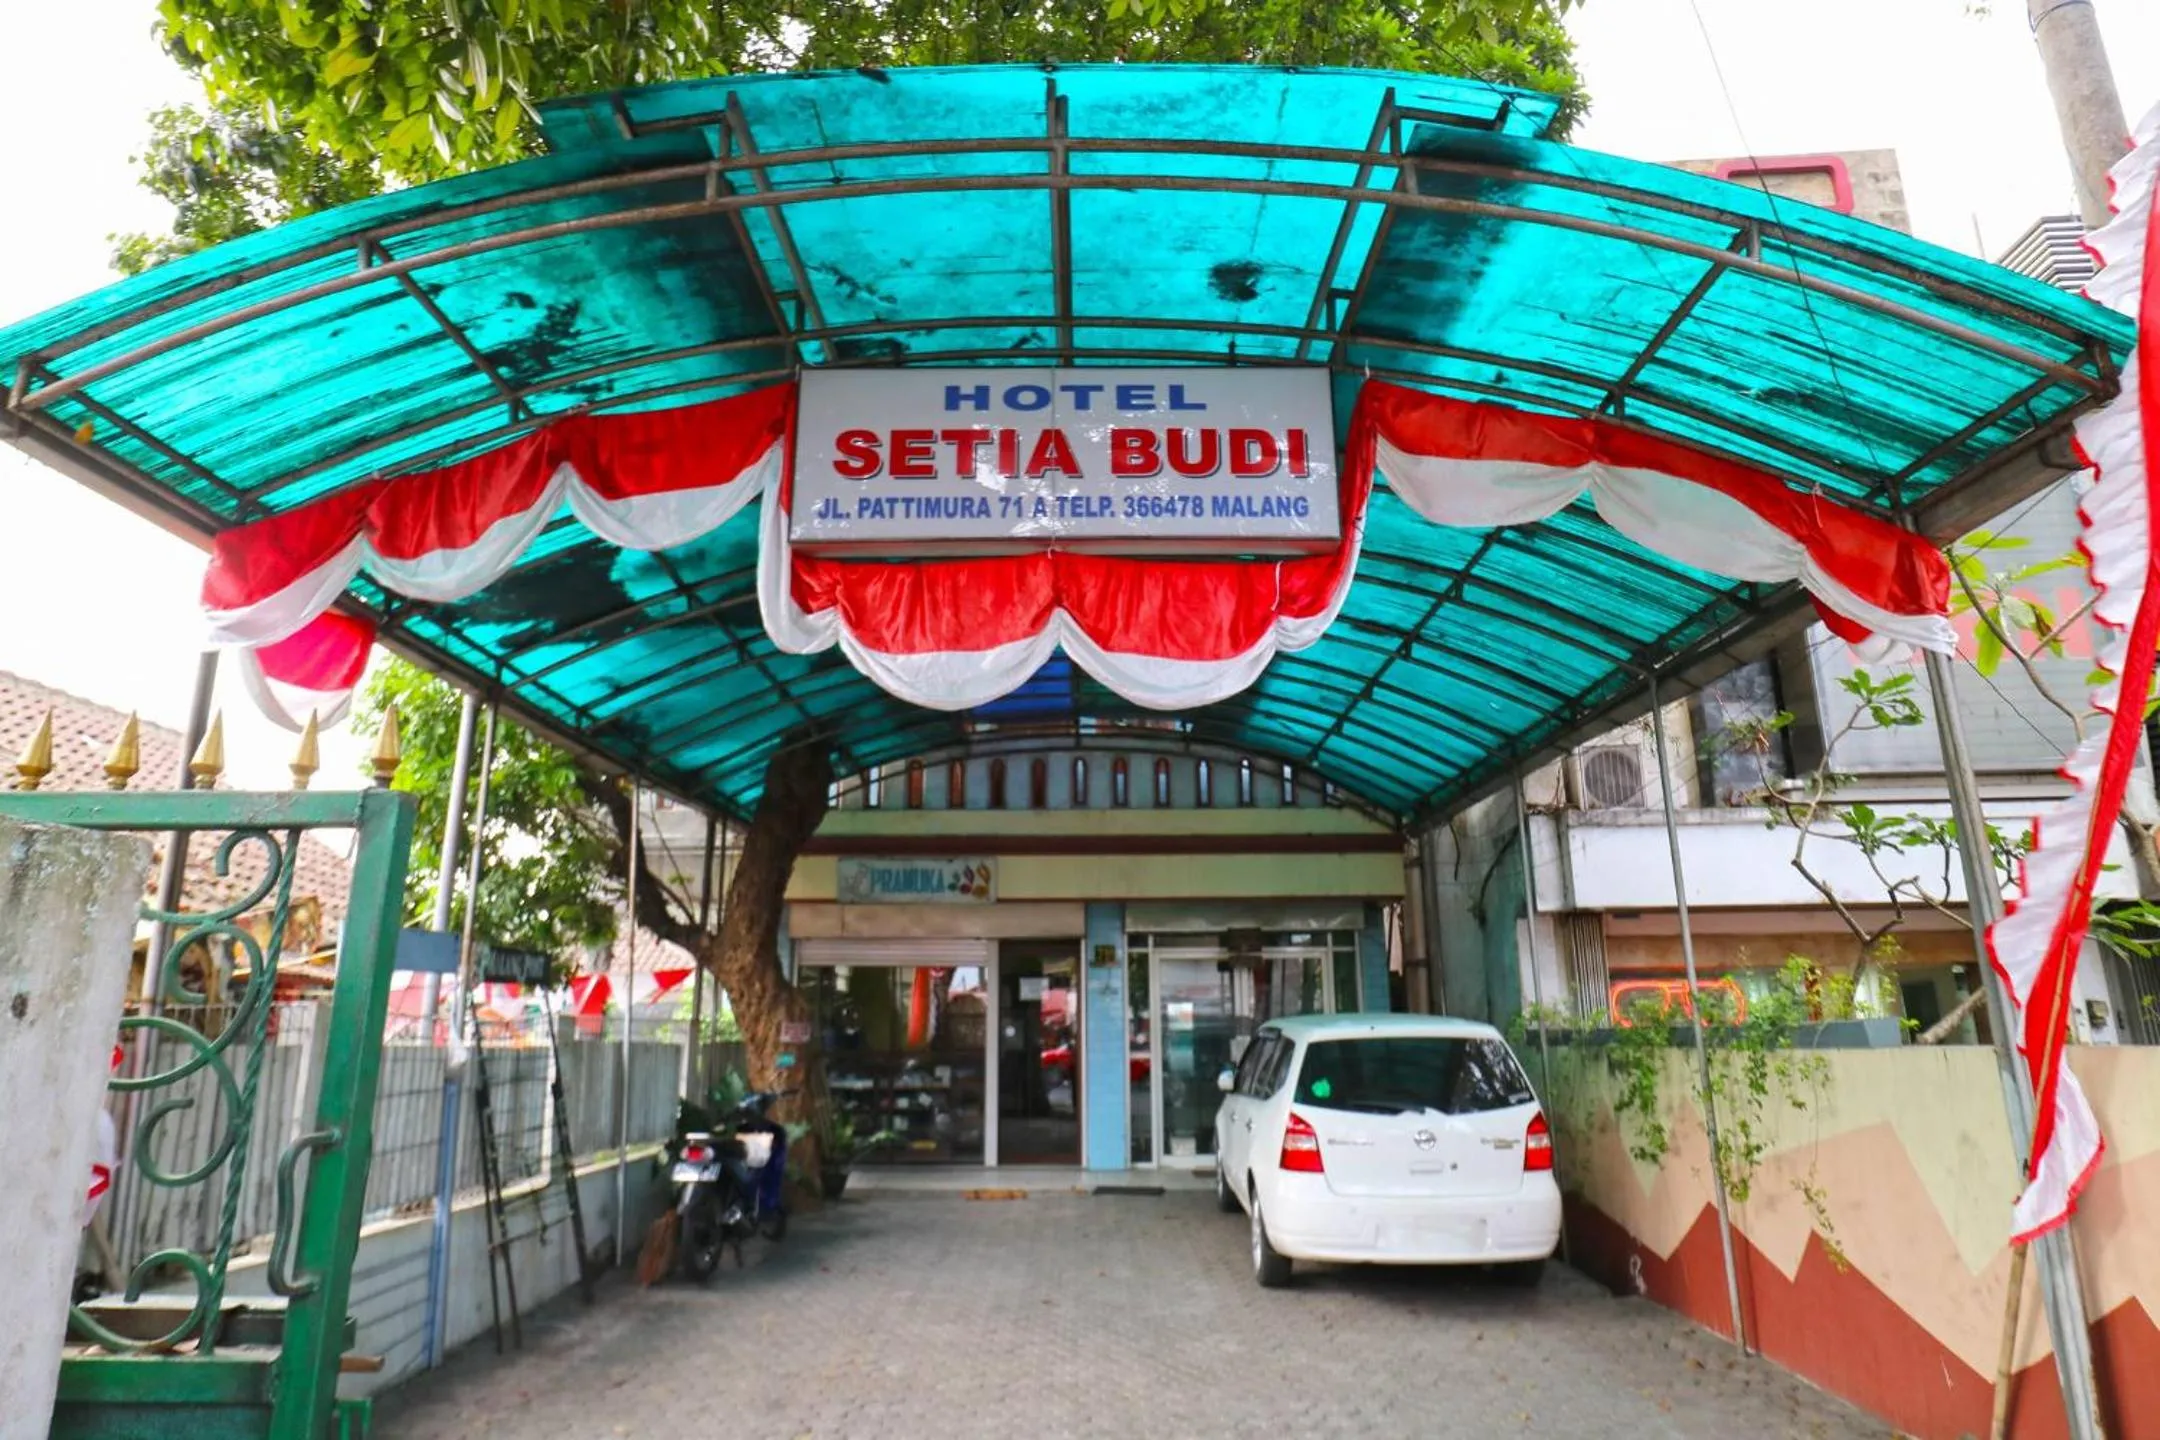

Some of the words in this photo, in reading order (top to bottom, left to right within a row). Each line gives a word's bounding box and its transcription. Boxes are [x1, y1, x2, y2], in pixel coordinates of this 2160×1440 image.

[944, 384, 1207, 412] HOTEL
[832, 428, 1083, 479] SETIA
[1110, 427, 1309, 479] BUDI
[818, 497, 850, 520] JL.
[857, 496, 992, 519] PATTIMURA
[999, 496, 1024, 518] 71
[1033, 497, 1048, 518] A
[1056, 496, 1116, 518] TELP.
[1123, 496, 1204, 518] 366478
[1211, 496, 1309, 518] MALANG
[870, 867, 945, 894] PRAMUKA
